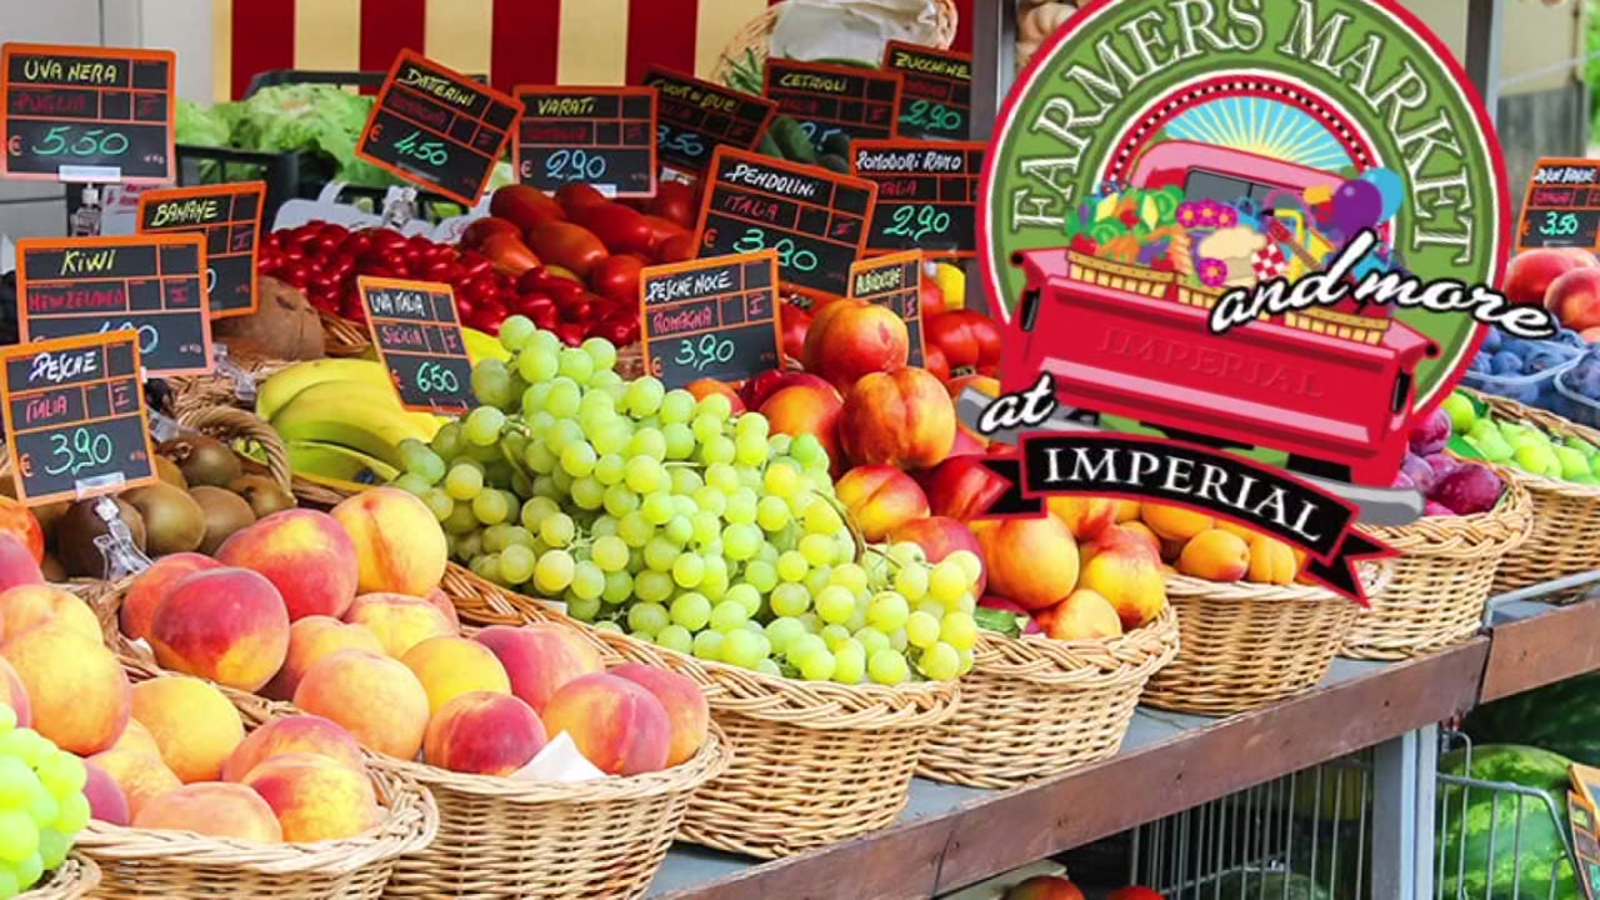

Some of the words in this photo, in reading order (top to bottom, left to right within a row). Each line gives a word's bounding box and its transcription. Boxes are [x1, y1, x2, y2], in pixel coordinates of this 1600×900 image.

[24, 60, 62, 80] UVA
[67, 62, 118, 83] NERA
[923, 151, 962, 171] RAMO
[151, 200, 219, 227] BANANE
[645, 276, 692, 301] PESCHE
[29, 351, 98, 383] PESCHE
